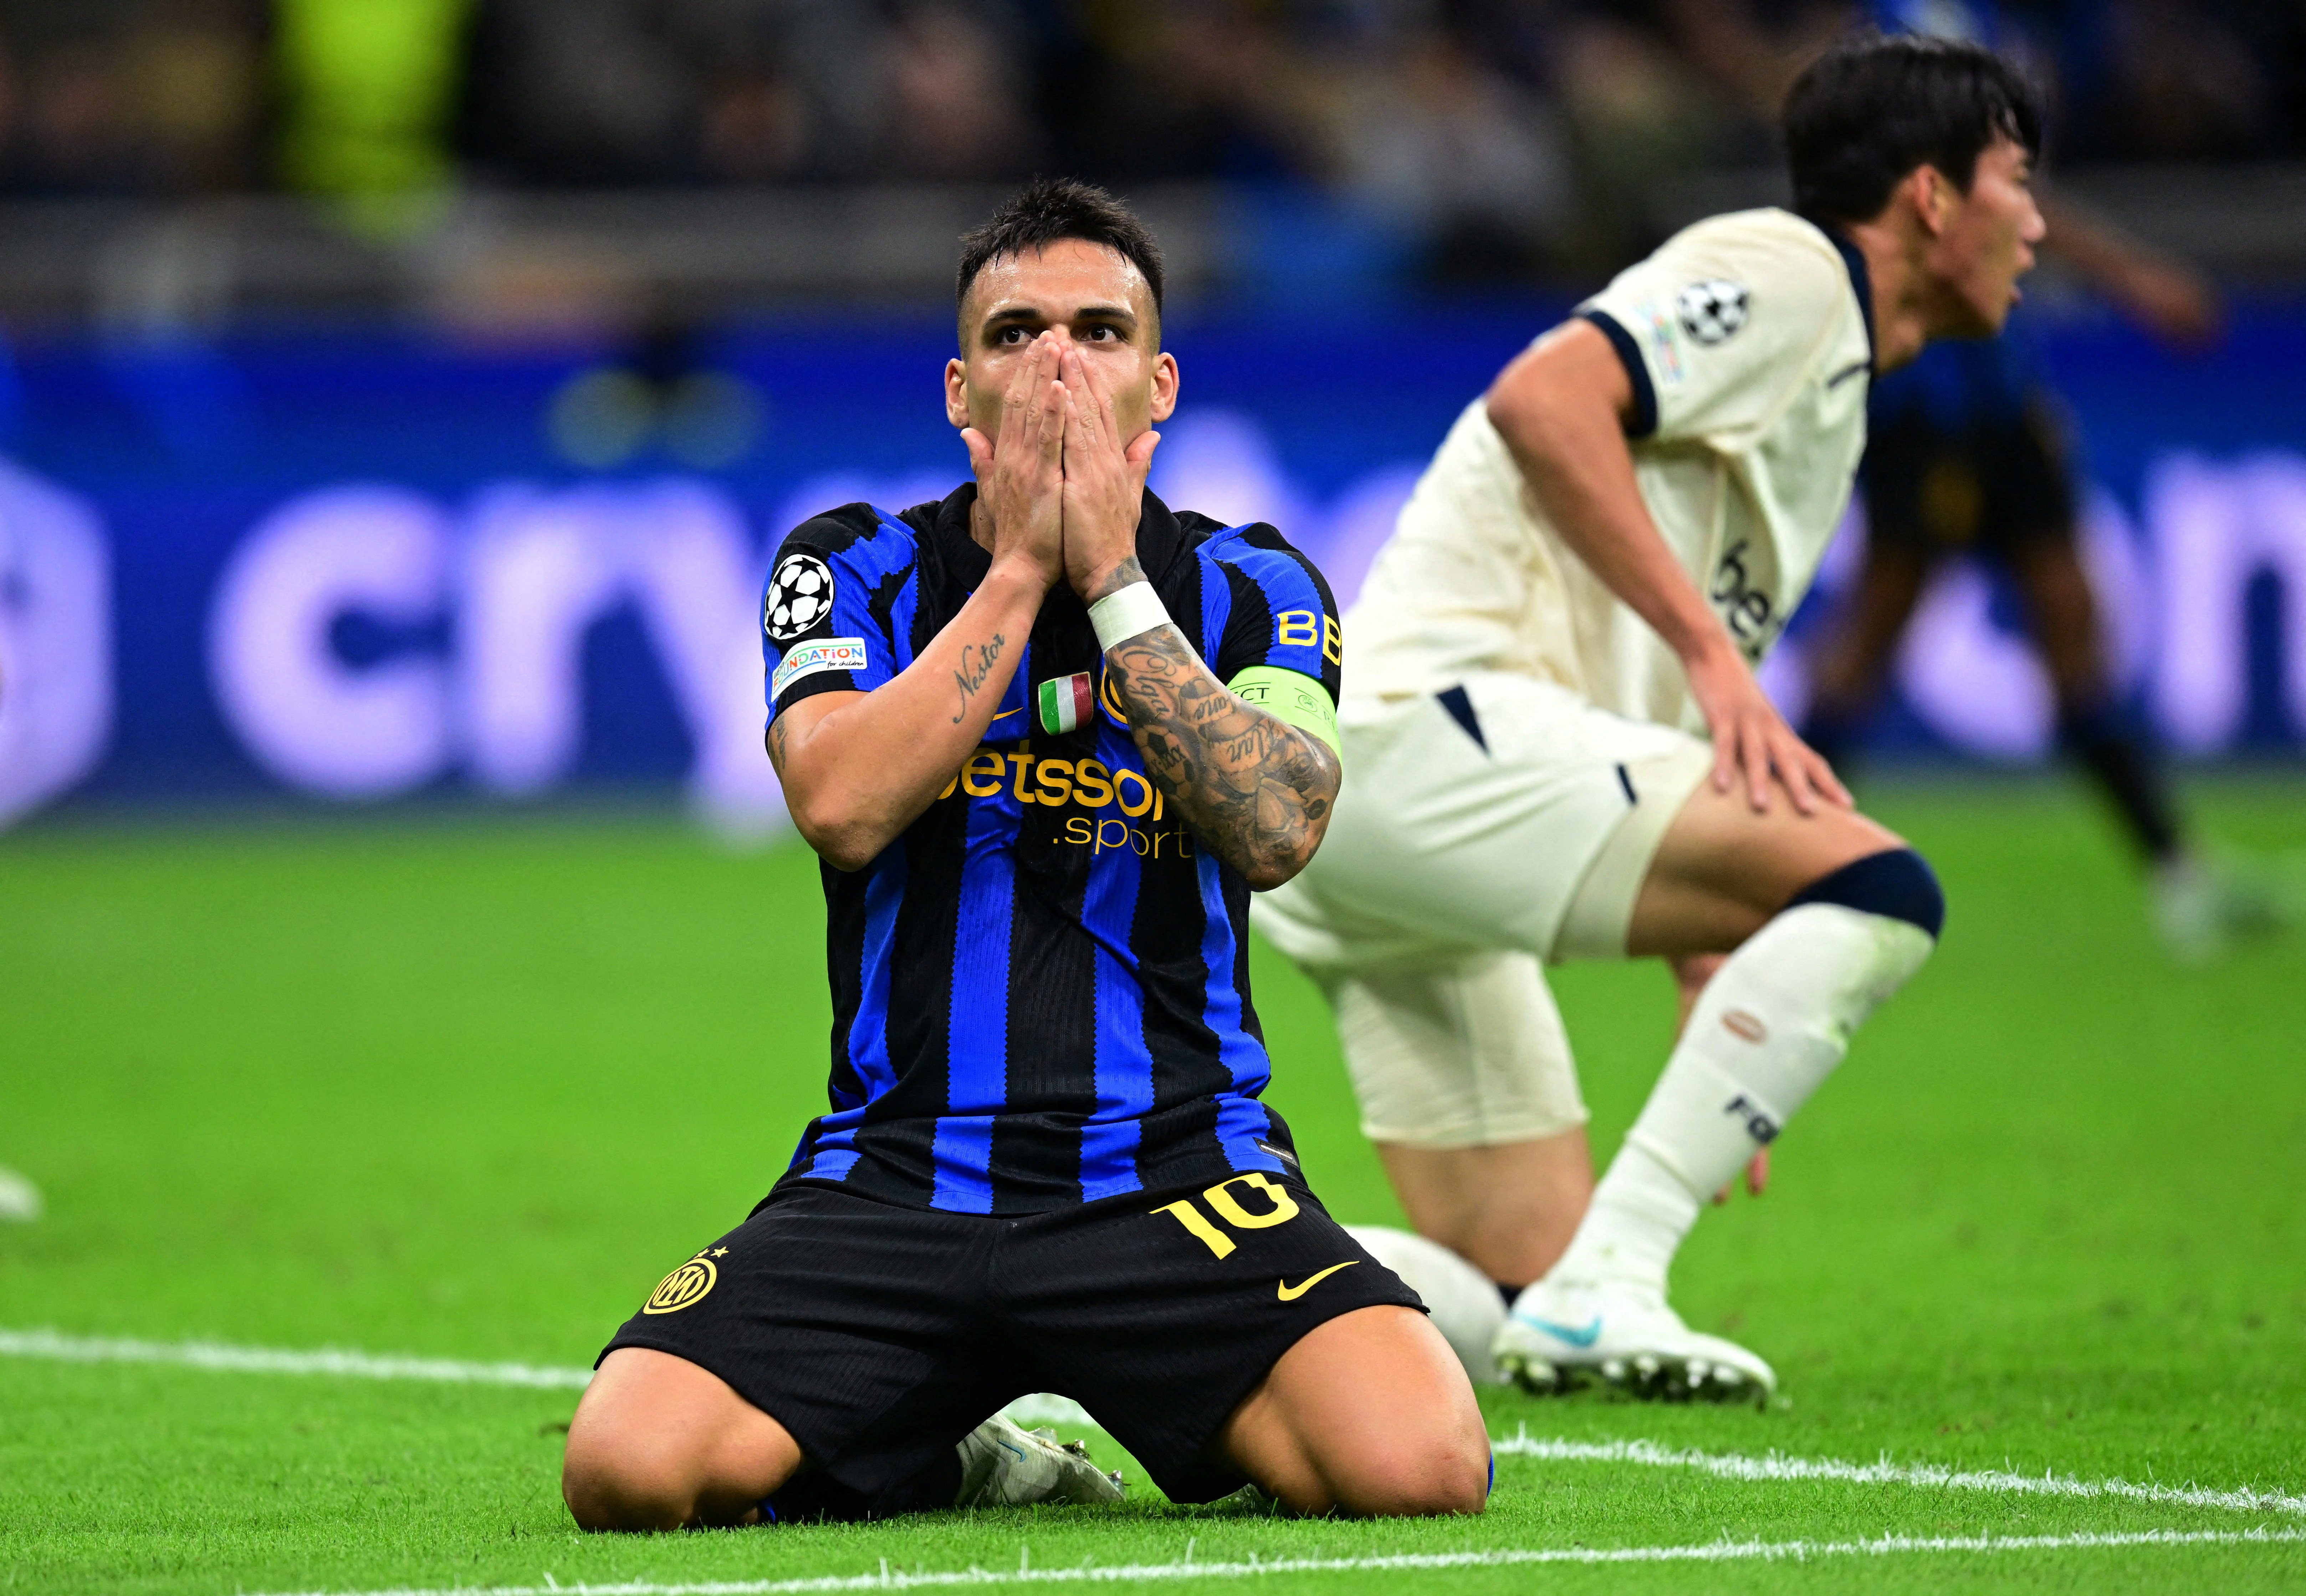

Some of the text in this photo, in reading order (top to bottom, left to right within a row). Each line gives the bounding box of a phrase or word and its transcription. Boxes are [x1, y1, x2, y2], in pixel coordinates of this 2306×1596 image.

[827, 660, 837, 669] for
[953, 633, 1005, 724] Nestor
[938, 740, 1163, 821] etsso
[1053, 818, 1191, 859] .sport
[1148, 1172, 1300, 1260] 10
